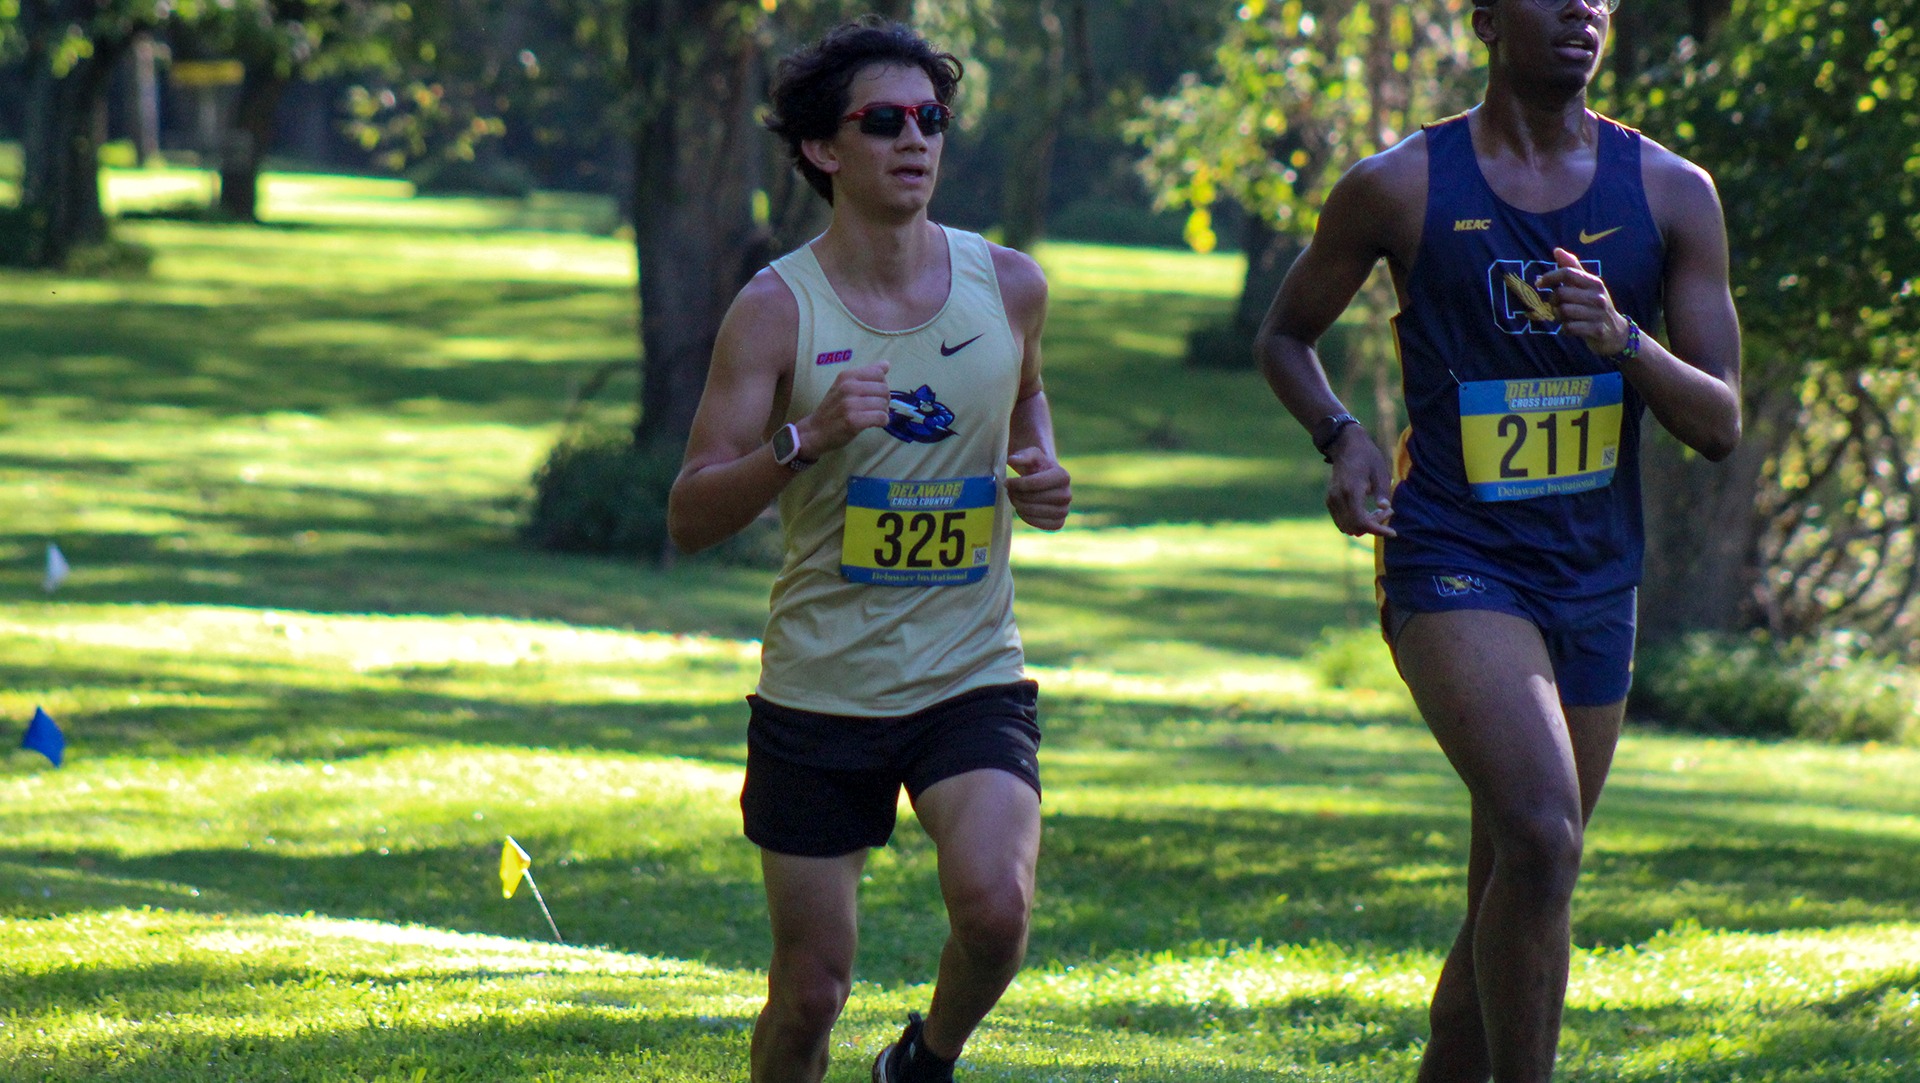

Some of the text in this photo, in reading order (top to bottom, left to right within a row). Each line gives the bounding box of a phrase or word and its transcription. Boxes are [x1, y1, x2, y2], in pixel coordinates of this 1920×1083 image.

[1453, 219, 1492, 231] MEAC
[1507, 380, 1589, 397] DELAWARE
[1511, 396, 1582, 408] CROSS COUNTRY
[1497, 410, 1590, 479] 211
[889, 482, 962, 498] DELAWARE
[1497, 475, 1597, 497] Delaware Invitational
[892, 496, 954, 506] CROSS COUNTRY
[873, 511, 967, 568] 325
[871, 570, 968, 582] Delaware Invitational
